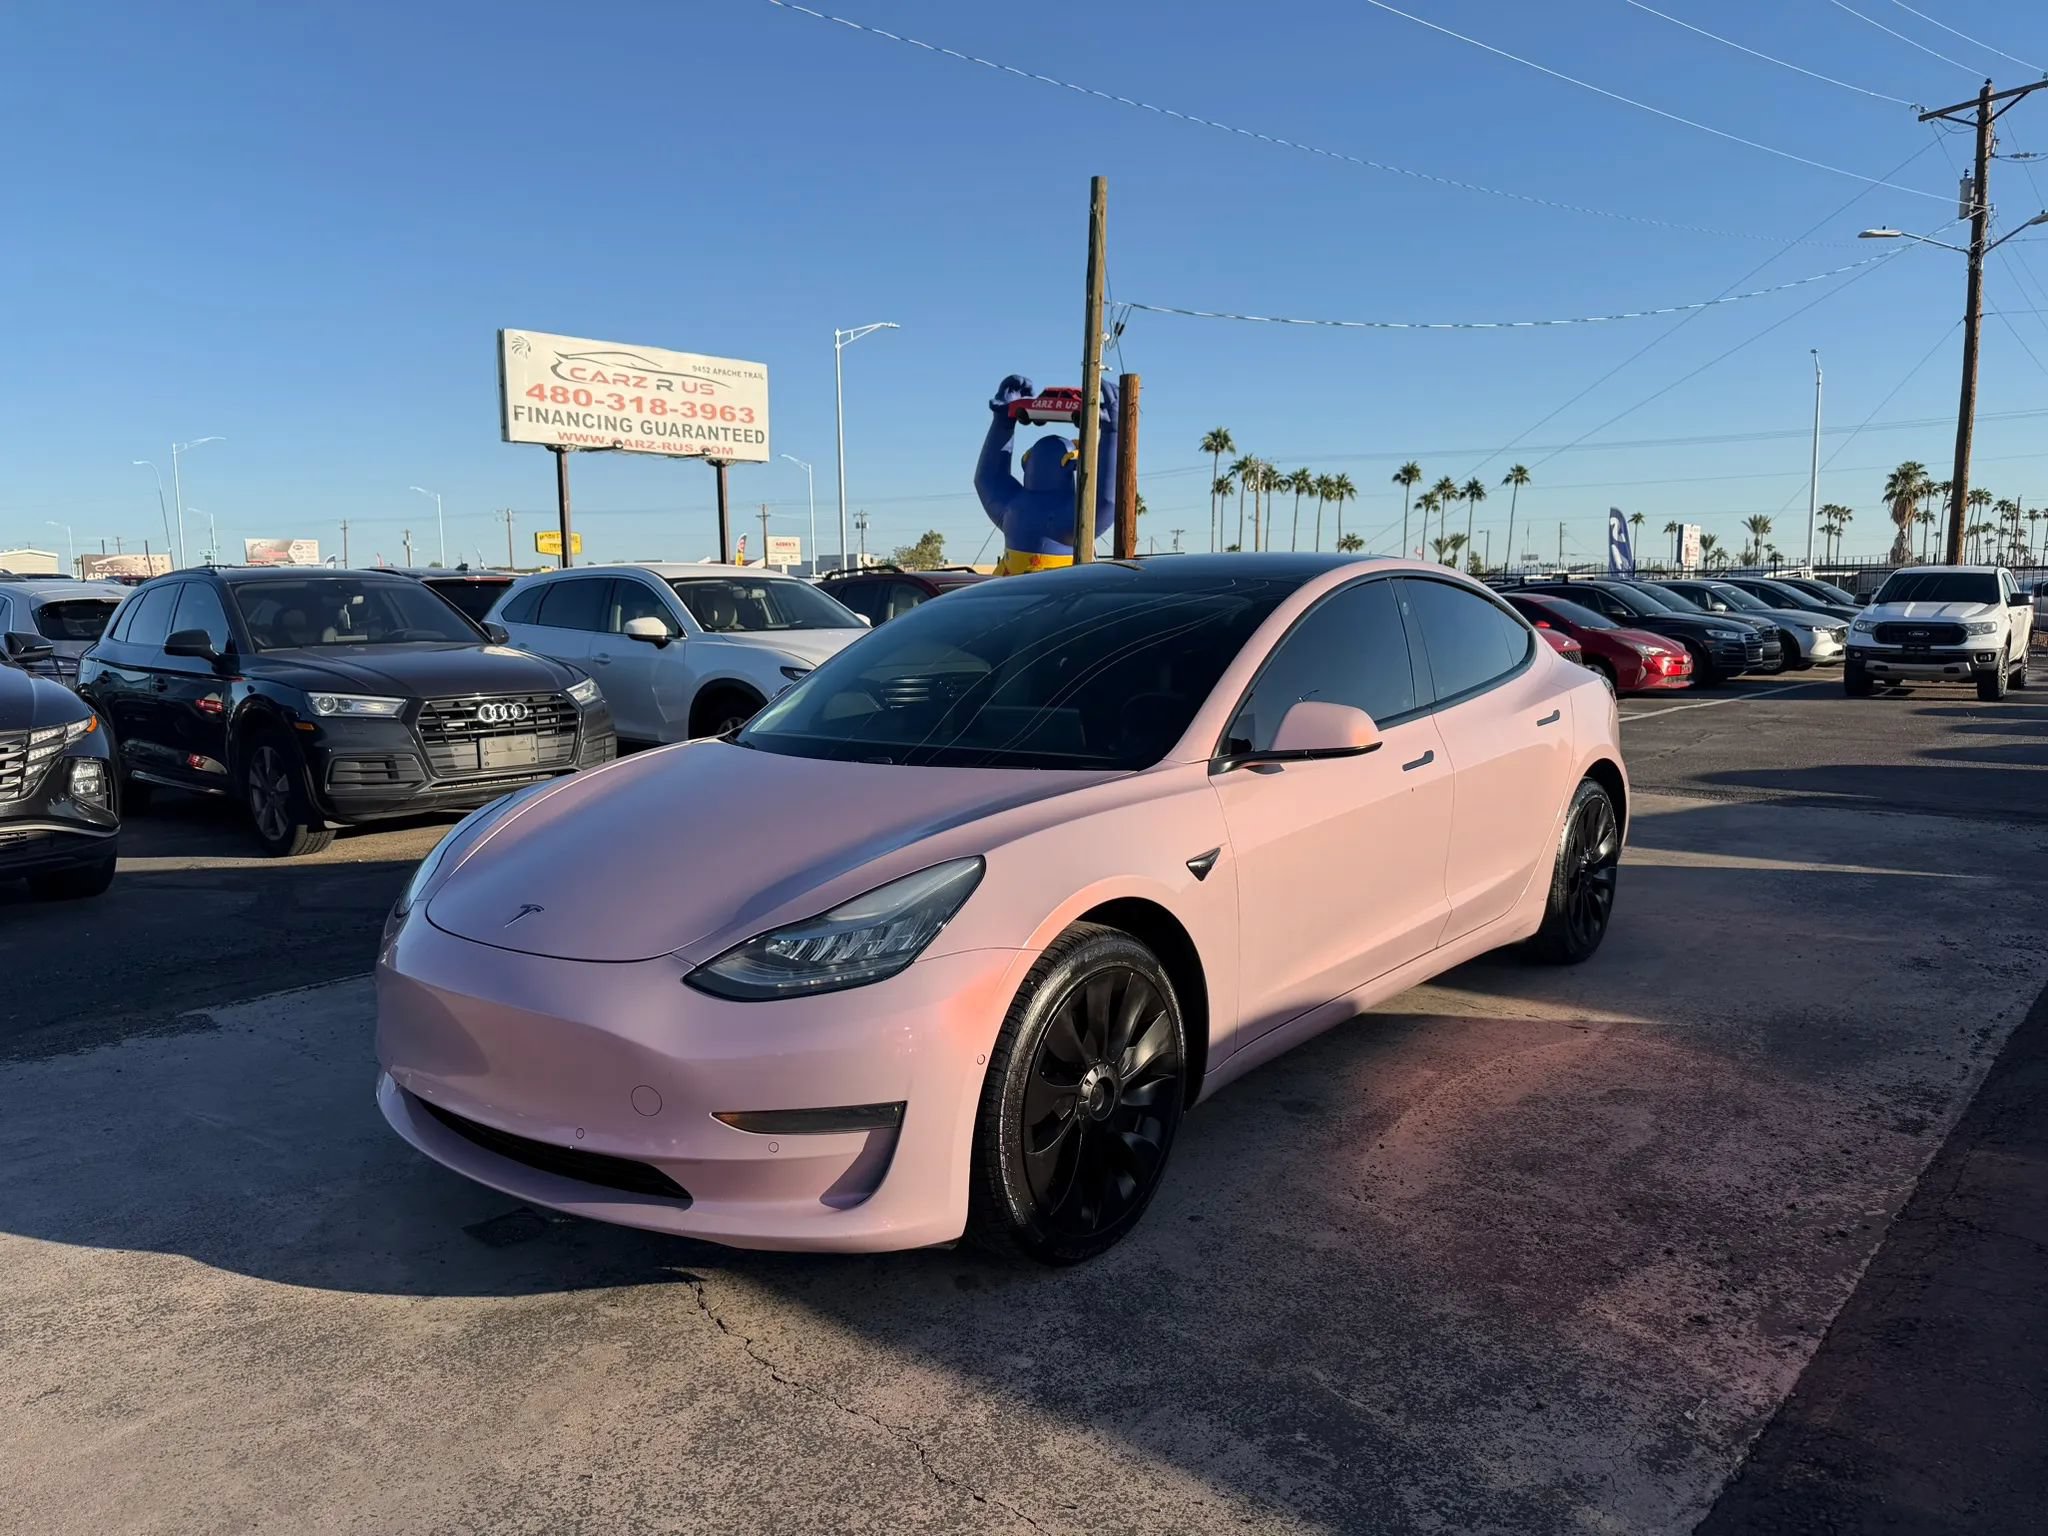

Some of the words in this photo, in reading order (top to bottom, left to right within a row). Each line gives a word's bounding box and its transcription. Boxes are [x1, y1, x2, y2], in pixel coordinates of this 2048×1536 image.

[570, 367, 648, 388] CARZ
[656, 378, 674, 392] R
[681, 381, 715, 396] US
[713, 367, 741, 378] APACHE
[525, 383, 755, 424] 480-318-3963
[1031, 400, 1053, 409] CARZ
[1056, 400, 1063, 409] R
[1065, 401, 1080, 410] US
[513, 404, 633, 433] FINANCING
[640, 419, 766, 444] GUARANTEED
